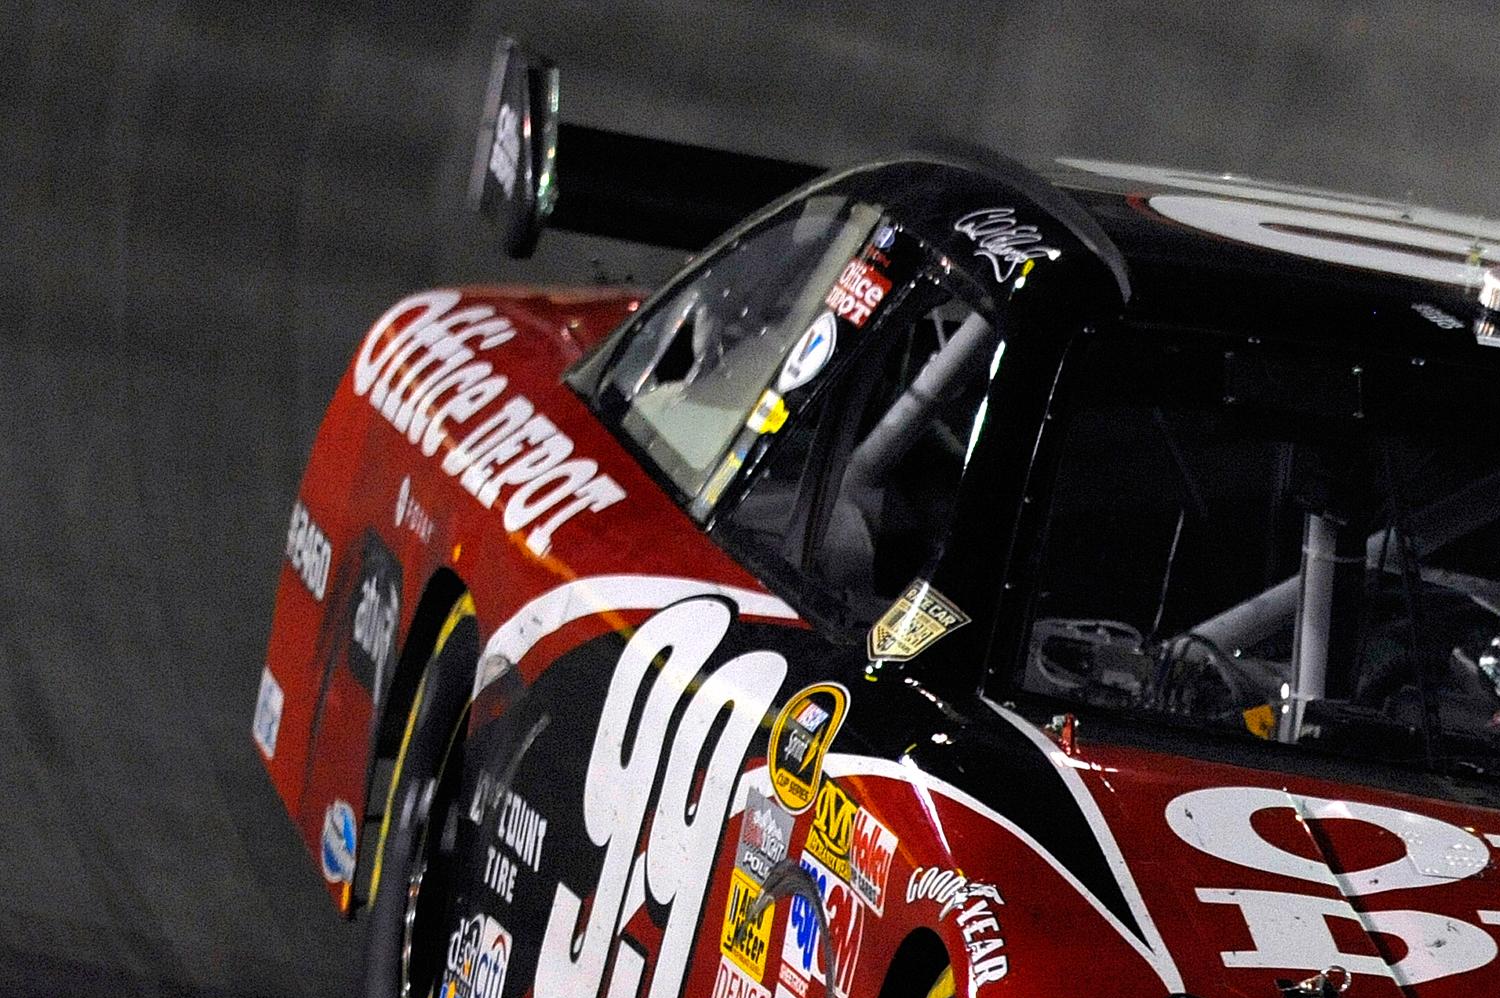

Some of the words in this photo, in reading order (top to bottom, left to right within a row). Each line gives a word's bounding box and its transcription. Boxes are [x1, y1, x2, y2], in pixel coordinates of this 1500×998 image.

[354, 288, 517, 457] Office
[441, 395, 627, 559] DEPOT
[905, 588, 934, 610] RAE
[928, 604, 957, 627] CAR
[470, 770, 549, 873] DCOUNT
[761, 830, 785, 863] LIGHT
[484, 846, 519, 904] TIRE
[743, 851, 771, 878] POL
[906, 866, 1008, 988] GOODYEAR
